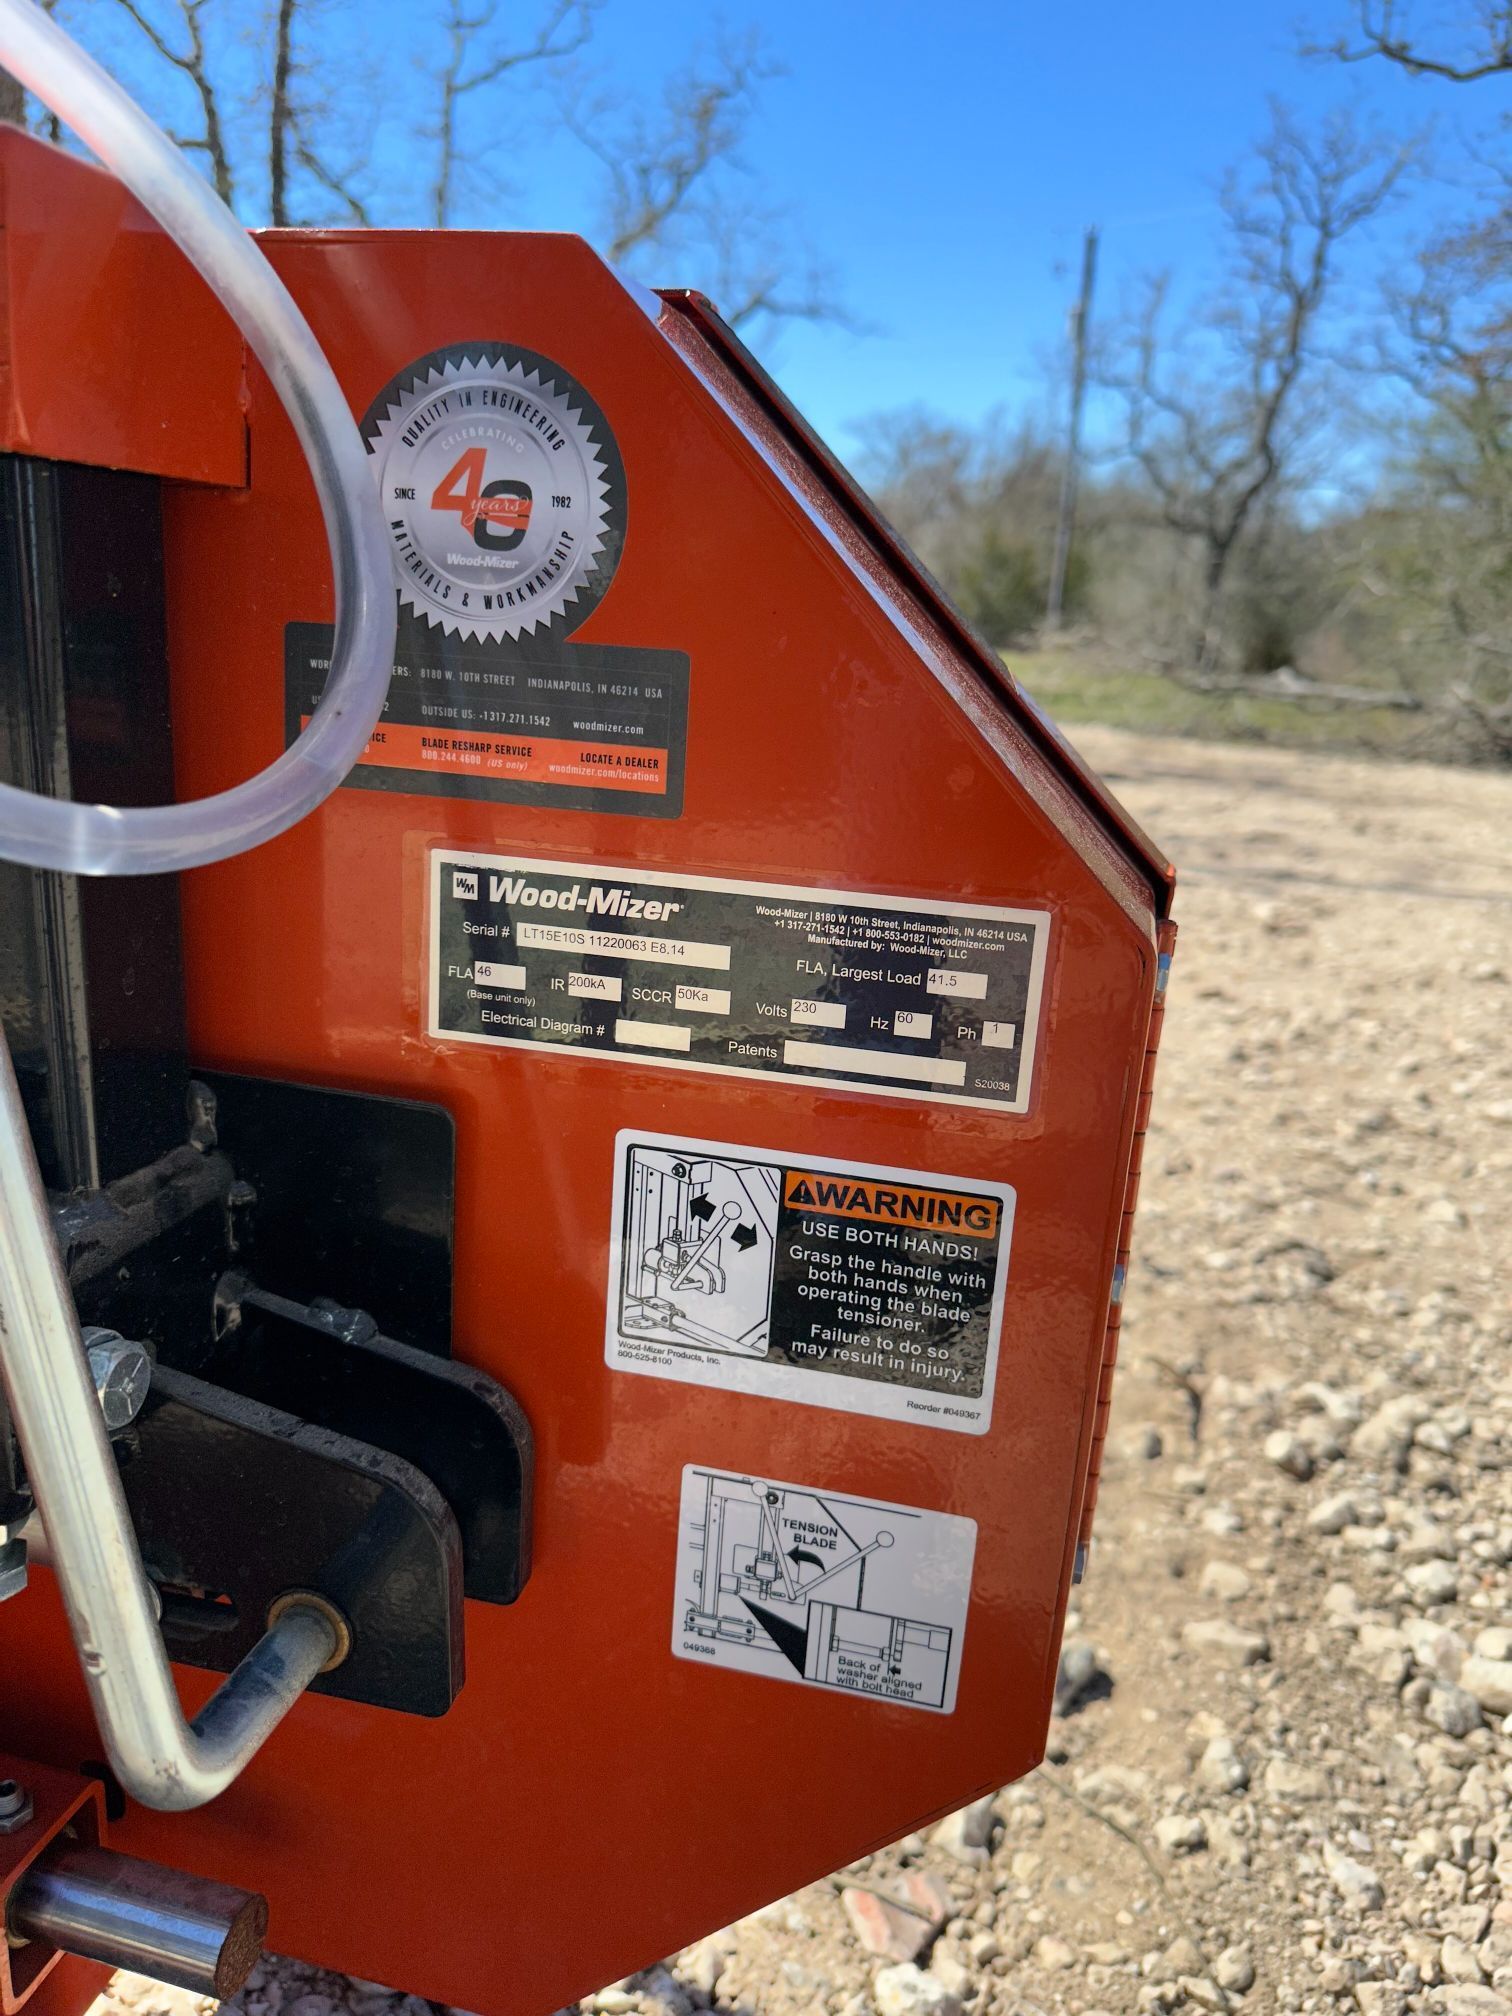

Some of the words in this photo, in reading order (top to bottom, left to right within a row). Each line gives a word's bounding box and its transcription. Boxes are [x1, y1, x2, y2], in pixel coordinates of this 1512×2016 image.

[402, 398, 449, 448] QUALITY
[459, 391, 472, 408] IN
[483, 390, 566, 451] ENGINEERING
[441, 427, 525, 453] CELEBRATING
[394, 487, 416, 501] SINCE
[431, 447, 533, 552] 40
[551, 496, 572, 509] 1982
[463, 496, 529, 526] years
[391, 520, 451, 599] MATERIALS
[462, 592, 469, 607] &
[484, 531, 575, 610] WORKMANSHIP
[447, 553, 520, 569] Wood-Mizer
[420, 668, 442, 680] 8180
[445, 670, 455, 680] W.
[459, 671, 480, 683] 10TH
[483, 673, 515, 686] STREET
[527, 677, 594, 694] INDIANAPOLIS,
[597, 683, 607, 694] IN
[610, 685, 638, 696] 46214
[645, 687, 663, 699] USA
[421, 705, 458, 718] OUTSIDE
[461, 709, 476, 719] US:
[572, 721, 644, 735] woodmizer.com
[421, 737, 449, 749] BLADE
[452, 740, 492, 753] RESHARP
[495, 744, 532, 757] SERVICE
[421, 749, 481, 765] 800.244.4600
[487, 758, 503, 769] (US
[506, 761, 528, 772] only)
[580, 752, 613, 765] LOCATE
[616, 756, 622, 766] A
[625, 756, 659, 769] DEALER
[548, 763, 659, 782] woodmizer.com/locations
[489, 875, 680, 922] Wood-Mizer
[755, 905, 808, 919] Wood-Mizer
[815, 912, 836, 923] 8180
[838, 914, 848, 924] W
[850, 915, 869, 926] 10th
[871, 918, 900, 930] Street,
[903, 921, 961, 937] Indianapolis,
[964, 927, 974, 937] IN
[976, 929, 1004, 940] 46214
[1006, 932, 1028, 943] USA
[462, 921, 498, 937] Serial
[501, 926, 511, 938] #
[524, 927, 585, 945] LT15E10S
[589, 935, 647, 952] 11220063
[651, 941, 685, 956] E8.14
[774, 920, 785, 928] +1
[787, 920, 845, 935] 317-271-1542
[852, 928, 863, 937] +1
[865, 929, 925, 943] 800-553-0182
[932, 936, 1005, 952] woodmizer.com
[807, 933, 869, 949] Manufactured
[871, 941, 885, 952] by:
[890, 943, 946, 959] Wood-Mizer,
[948, 950, 968, 960] LLC
[448, 965, 474, 980] FLA
[477, 966, 492, 978] 46
[551, 978, 565, 991] IR
[568, 975, 606, 990] 200kA
[796, 959, 827, 977] FLA,
[832, 963, 883, 983] Largest
[887, 969, 921, 986] Load
[928, 973, 957, 986] 41.5
[466, 989, 496, 1002] (Base
[498, 992, 512, 1004] unit
[514, 995, 536, 1008] only)
[631, 987, 672, 1004] SCCR
[677, 988, 709, 1002] 50Ka
[755, 1001, 788, 1018] Volts
[793, 1000, 817, 1014] 230
[870, 1016, 889, 1030] Hz
[897, 1011, 914, 1024] 60
[481, 1011, 537, 1028] Electrical
[540, 1018, 593, 1037] Diagram
[596, 1024, 605, 1036] #
[957, 1025, 976, 1041] Ph
[992, 1022, 998, 1034] 1
[728, 1040, 778, 1059] Patents
[974, 1078, 1010, 1091] S20038
[815, 1181, 991, 1231] WARNING
[801, 1220, 840, 1239] USE
[846, 1227, 898, 1248] BOTH
[904, 1236, 978, 1261] HANDS!
[789, 1245, 842, 1268] Grasp
[847, 1254, 876, 1271] the
[881, 1258, 942, 1282] handle
[948, 1271, 986, 1289] with
[808, 1266, 848, 1285] both
[853, 1273, 908, 1294] hands
[914, 1284, 963, 1303] when
[797, 1284, 881, 1311] operating
[887, 1296, 915, 1313] the
[921, 1301, 971, 1323] blade
[837, 1306, 925, 1333] tensioner.
[618, 1340, 666, 1356] Wood-Mizer
[667, 1348, 704, 1363] Products,
[706, 1355, 721, 1365] Inc.
[810, 1323, 871, 1347] Failure
[876, 1336, 894, 1351] to
[899, 1338, 922, 1356] do
[927, 1347, 950, 1361] so
[791, 1340, 828, 1360] may
[833, 1348, 884, 1367] result
[889, 1354, 904, 1370] in
[911, 1358, 966, 1383] injury.
[906, 1400, 941, 1414] Reorder
[943, 1407, 981, 1420] #049367
[782, 1517, 838, 1537] TENSION
[793, 1533, 837, 1550] BLADE
[838, 1655, 866, 1669] Back
[869, 1663, 881, 1673] of
[836, 1675, 859, 1687] with
[862, 1681, 883, 1693] bolt
[885, 1684, 914, 1699] head
[837, 1667, 878, 1681] washer
[881, 1675, 922, 1691] aligned
